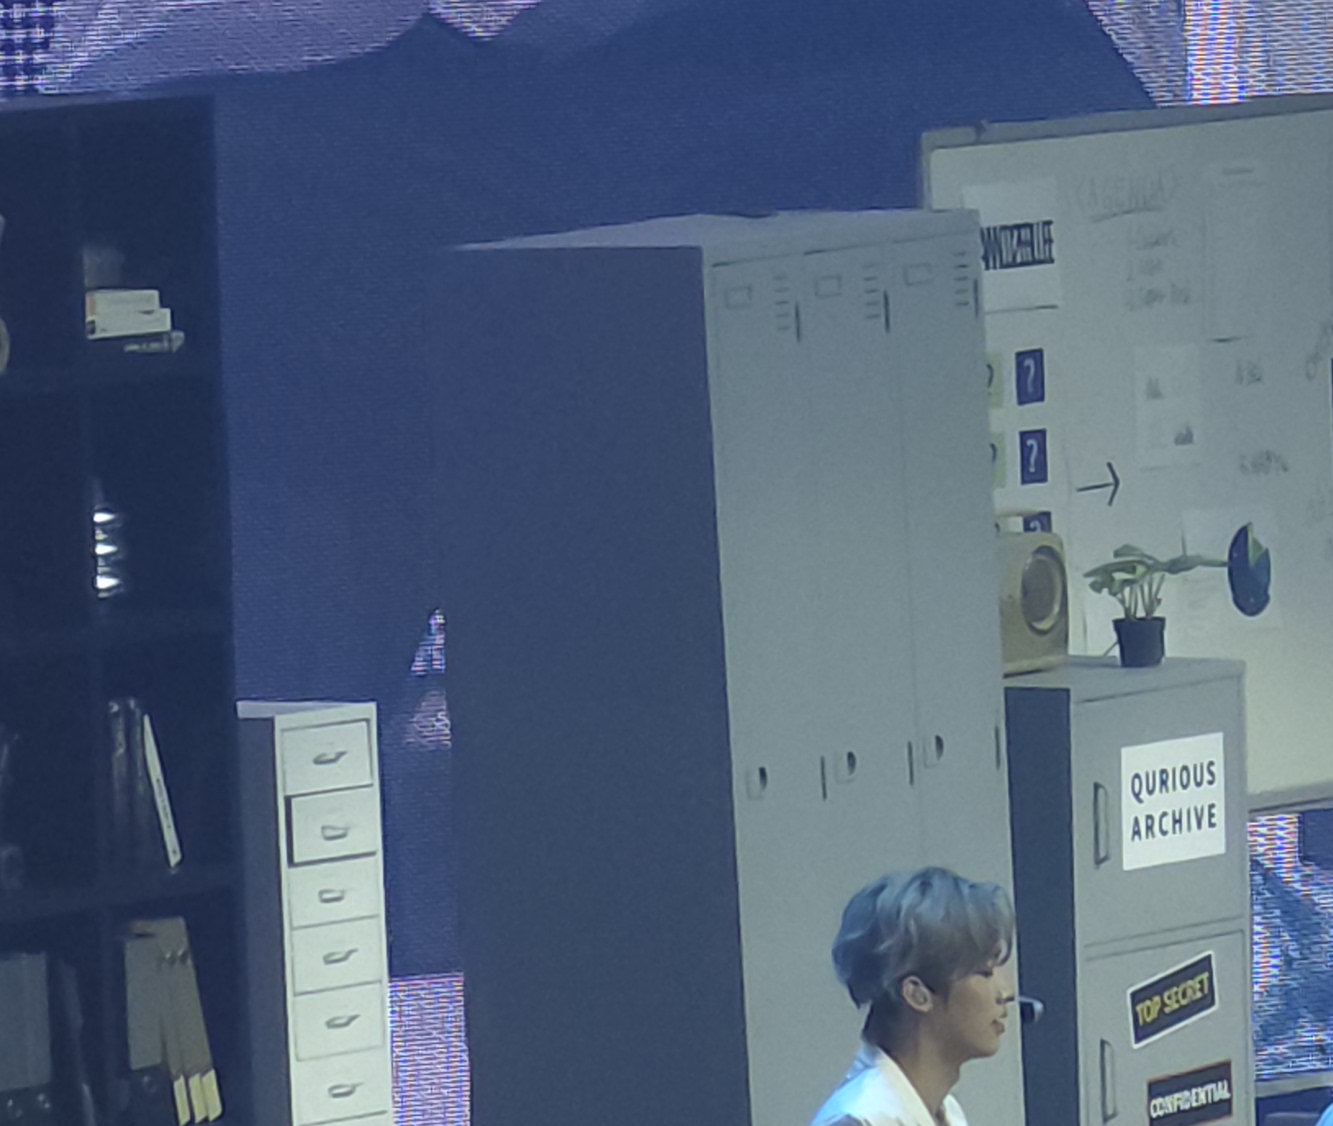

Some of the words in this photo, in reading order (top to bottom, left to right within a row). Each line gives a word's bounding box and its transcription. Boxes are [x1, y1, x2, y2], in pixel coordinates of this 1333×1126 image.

[1130, 760, 1217, 804] QURIOUS
[1130, 802, 1218, 842] ARCHIVE
[1135, 995, 1161, 1027] TOP
[1163, 971, 1210, 1014] SECRET
[1150, 1079, 1232, 1119] CONFIDENTIAL
